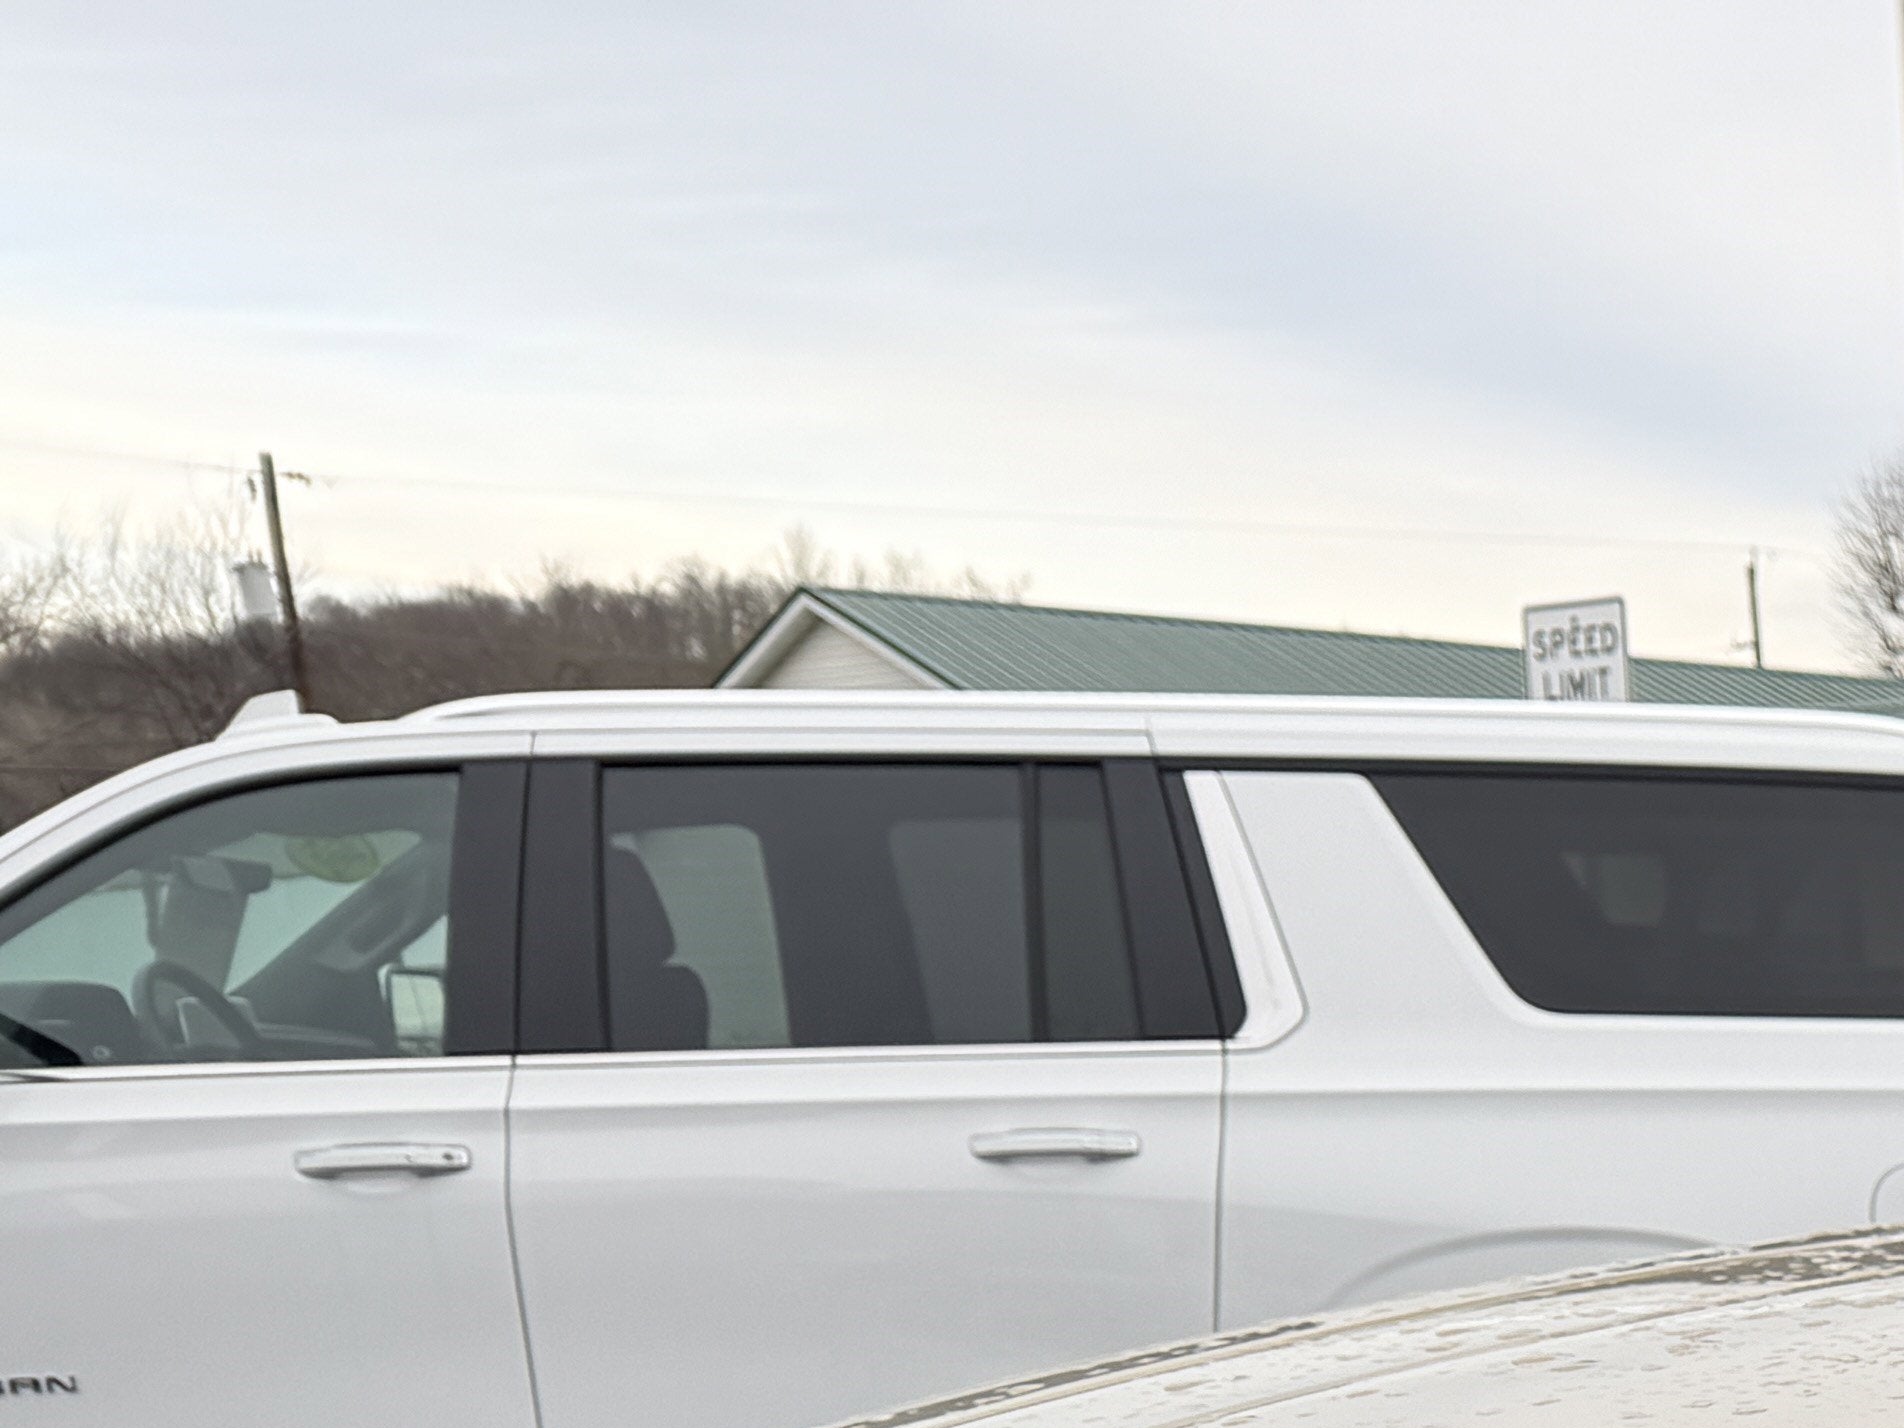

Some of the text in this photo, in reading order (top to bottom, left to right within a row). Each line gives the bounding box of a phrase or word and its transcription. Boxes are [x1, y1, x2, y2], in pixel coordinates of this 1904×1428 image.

[1532, 621, 1619, 662] SPEED
[1542, 665, 1612, 701] LIMIT
[0, 1375, 79, 1396] AN
